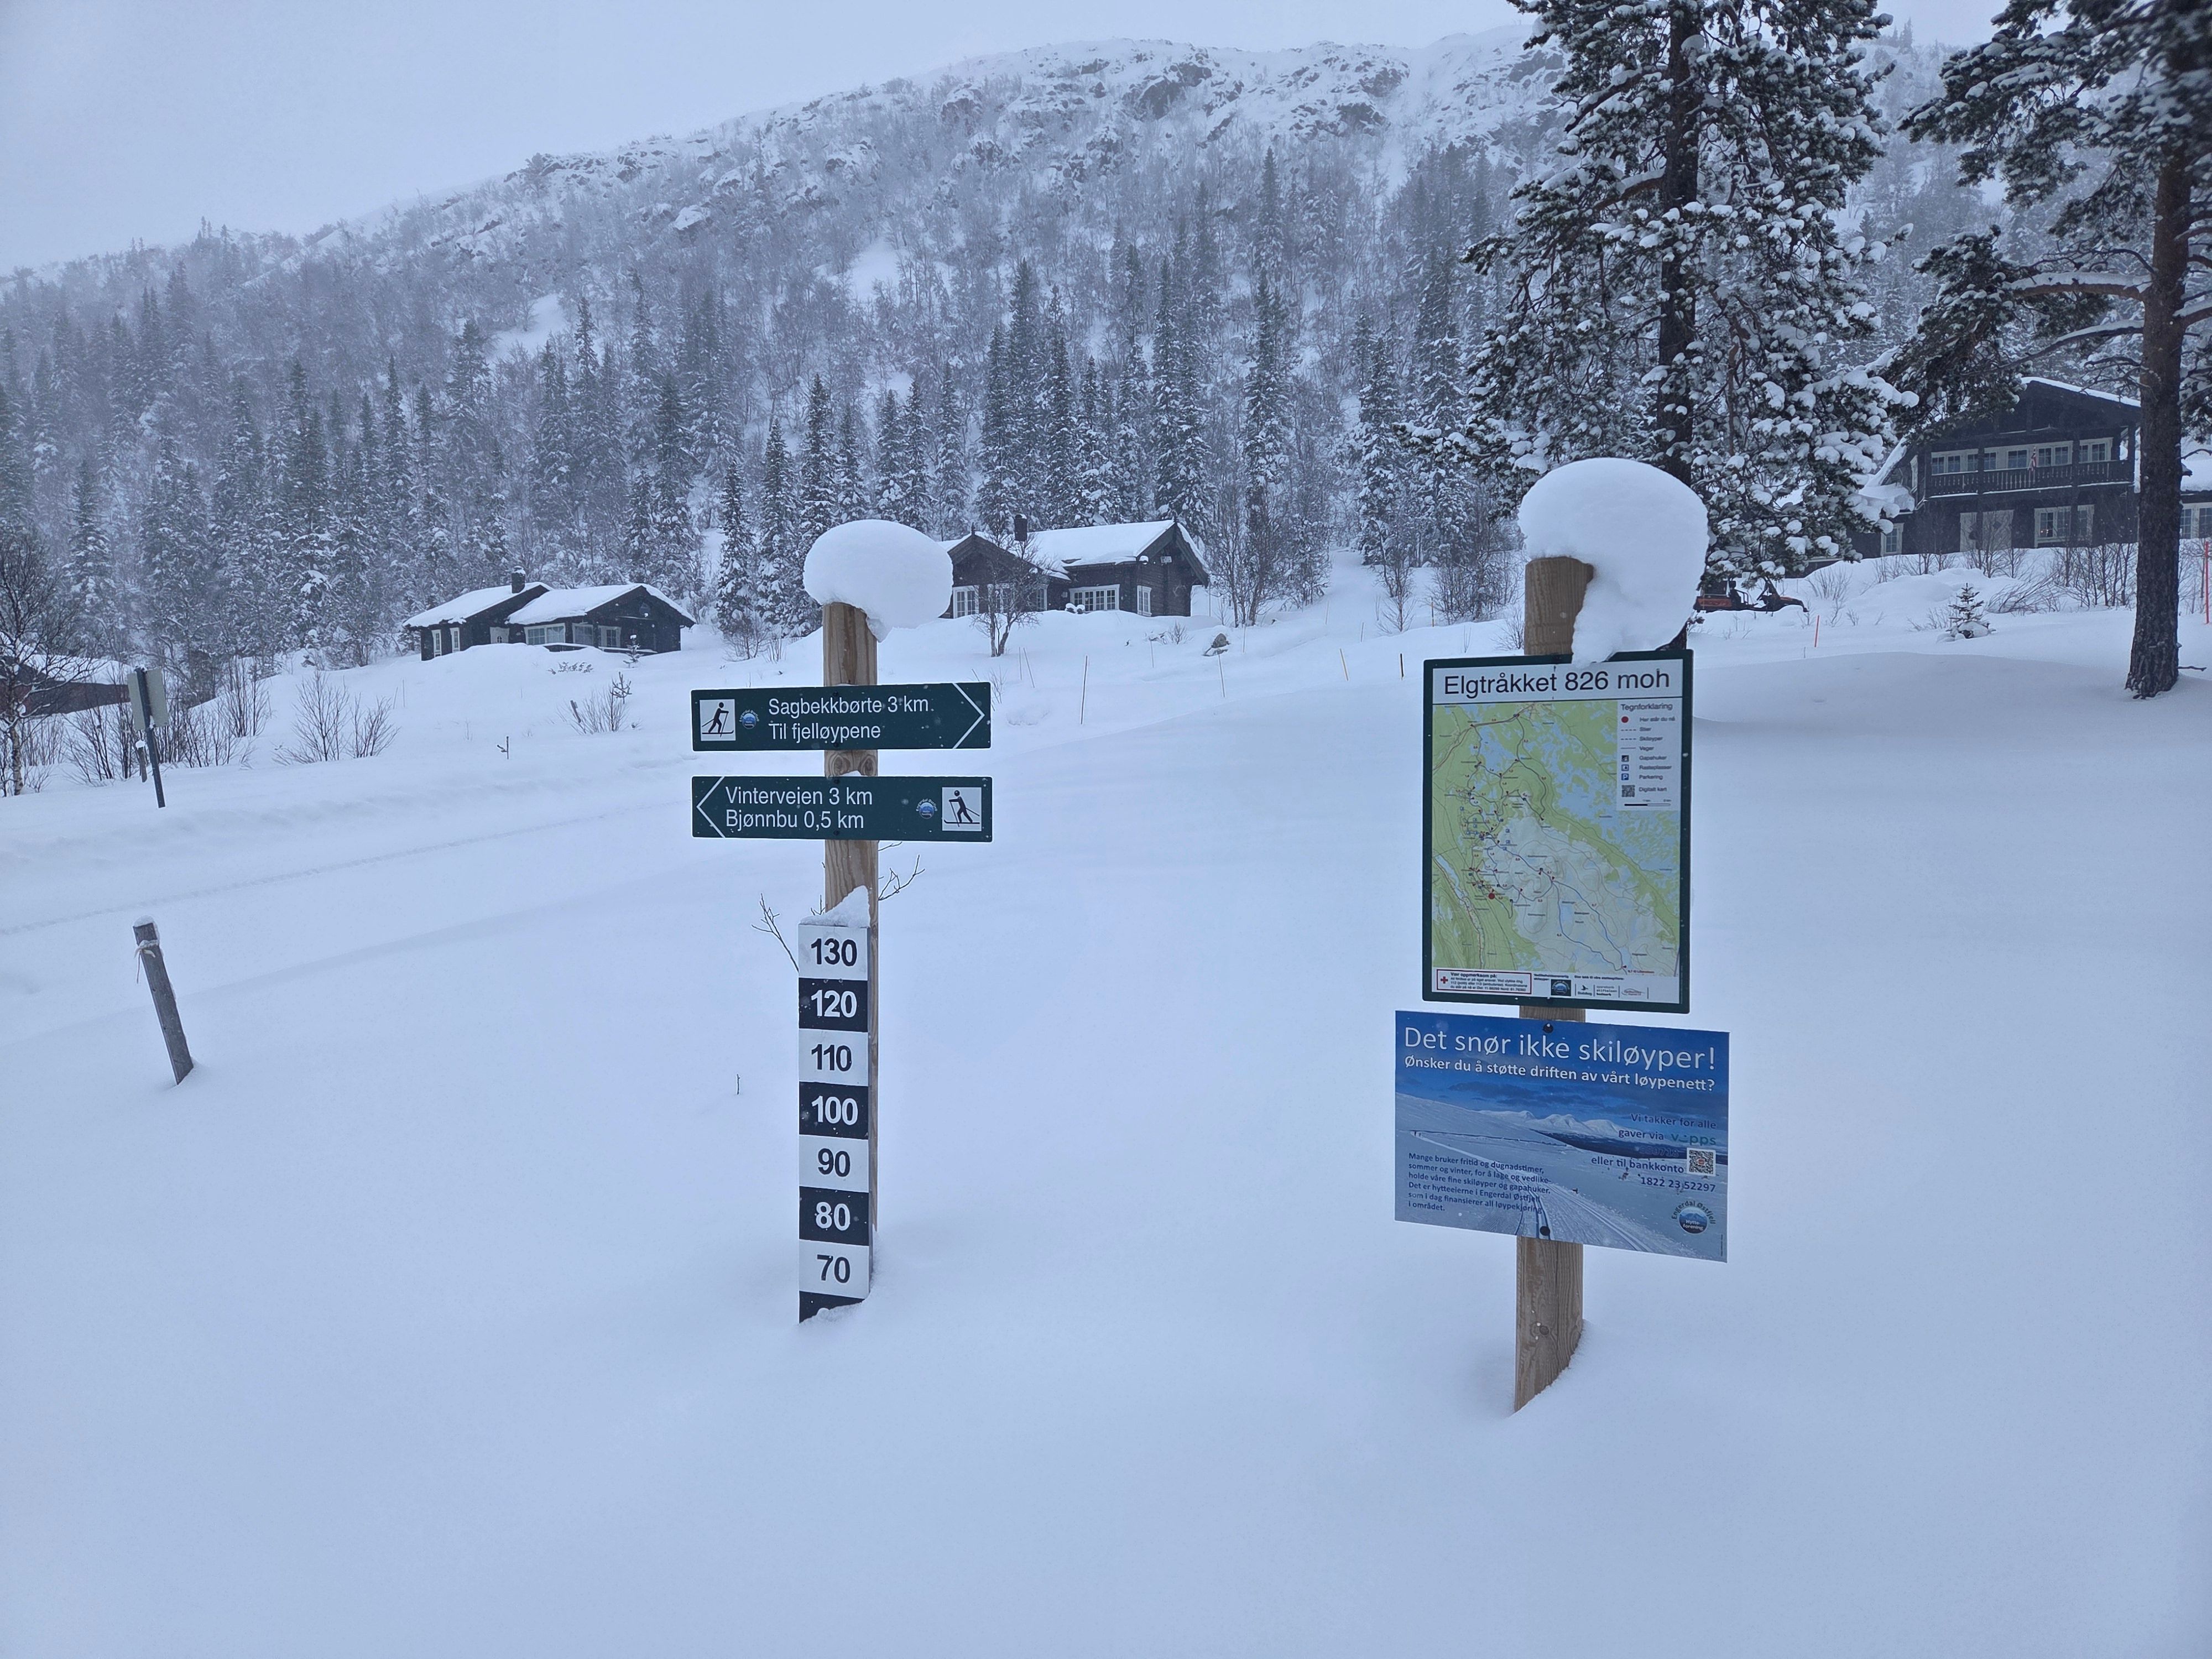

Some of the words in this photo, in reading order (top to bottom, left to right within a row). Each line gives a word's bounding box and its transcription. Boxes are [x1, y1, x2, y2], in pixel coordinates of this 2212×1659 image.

[1444, 672, 1557, 699] Elgtråkket
[1565, 671, 1609, 690] 826
[1618, 669, 1670, 688] moh
[768, 697, 883, 718] Sagbekkbørte
[888, 696, 898, 712] 3
[1621, 703, 1673, 711] Tegnforklaring
[768, 723, 787, 740] Til
[792, 722, 881, 743] fjelløypene
[725, 786, 823, 805] Vinterveien
[829, 787, 840, 805] 3
[846, 788, 873, 805] km
[726, 810, 797, 831] Bjønnbu
[804, 811, 831, 830] 0,5
[837, 811, 864, 828] km
[811, 938, 857, 967] 130
[811, 990, 857, 1018] 120
[811, 1044, 852, 1072] 110
[1404, 1026, 1448, 1050] Det
[1454, 1033, 1510, 1055] snør
[1519, 1034, 1570, 1058] ikke
[1579, 1040, 1715, 1072] skiløyper!
[1405, 1055, 1451, 1071] Ønsker
[1454, 1058, 1472, 1072] du
[1475, 1059, 1483, 1073] å
[1487, 1062, 1526, 1076] støtte
[1530, 1065, 1577, 1081] driften
[1581, 1070, 1598, 1082] av
[1601, 1068, 1630, 1084] vårt
[1635, 1072, 1715, 1092] løypenett?
[811, 1095, 858, 1126] 100
[1645, 1115, 1676, 1125] takker
[1680, 1118, 1694, 1126] for
[1698, 1120, 1717, 1129] alle
[1619, 1130, 1646, 1138] gaver
[1650, 1131, 1664, 1140] via
[818, 1147, 851, 1177] 90
[1408, 1153, 1433, 1162] Mange
[1435, 1155, 1458, 1164] bruker
[1460, 1157, 1478, 1166] fritid
[1490, 1161, 1544, 1174] dugnadstimer,
[1591, 1156, 1614, 1166] eller
[1616, 1159, 1626, 1167] til
[1630, 1160, 1684, 1173] bankkonto
[1408, 1163, 1438, 1171] sommer
[1450, 1168, 1473, 1176] vinter,
[1494, 1171, 1509, 1180] lage
[1522, 1175, 1551, 1183] vedlike-
[1408, 1172, 1428, 1180] holde
[1448, 1176, 1462, 1184] fine
[1463, 1177, 1496, 1188] skiløyper
[1509, 1183, 1551, 1194] gapahuker.
[1432, 1184, 1474, 1194] hytteeierne
[1480, 1190, 1511, 1200] Engerdal
[1514, 1193, 1540, 1202] Østfjell
[1641, 1177, 1665, 1187] 1822
[1668, 1180, 1681, 1188] 23
[1684, 1181, 1716, 1192] 52297
[1412, 1201, 1445, 1211] området.
[1429, 1193, 1442, 1202] dag
[1444, 1194, 1483, 1206] finansierer
[1485, 1198, 1494, 1207] all
[1495, 1199, 1542, 1213] løypekjøring
[815, 1202, 851, 1232] 80
[817, 1255, 851, 1284] 70
